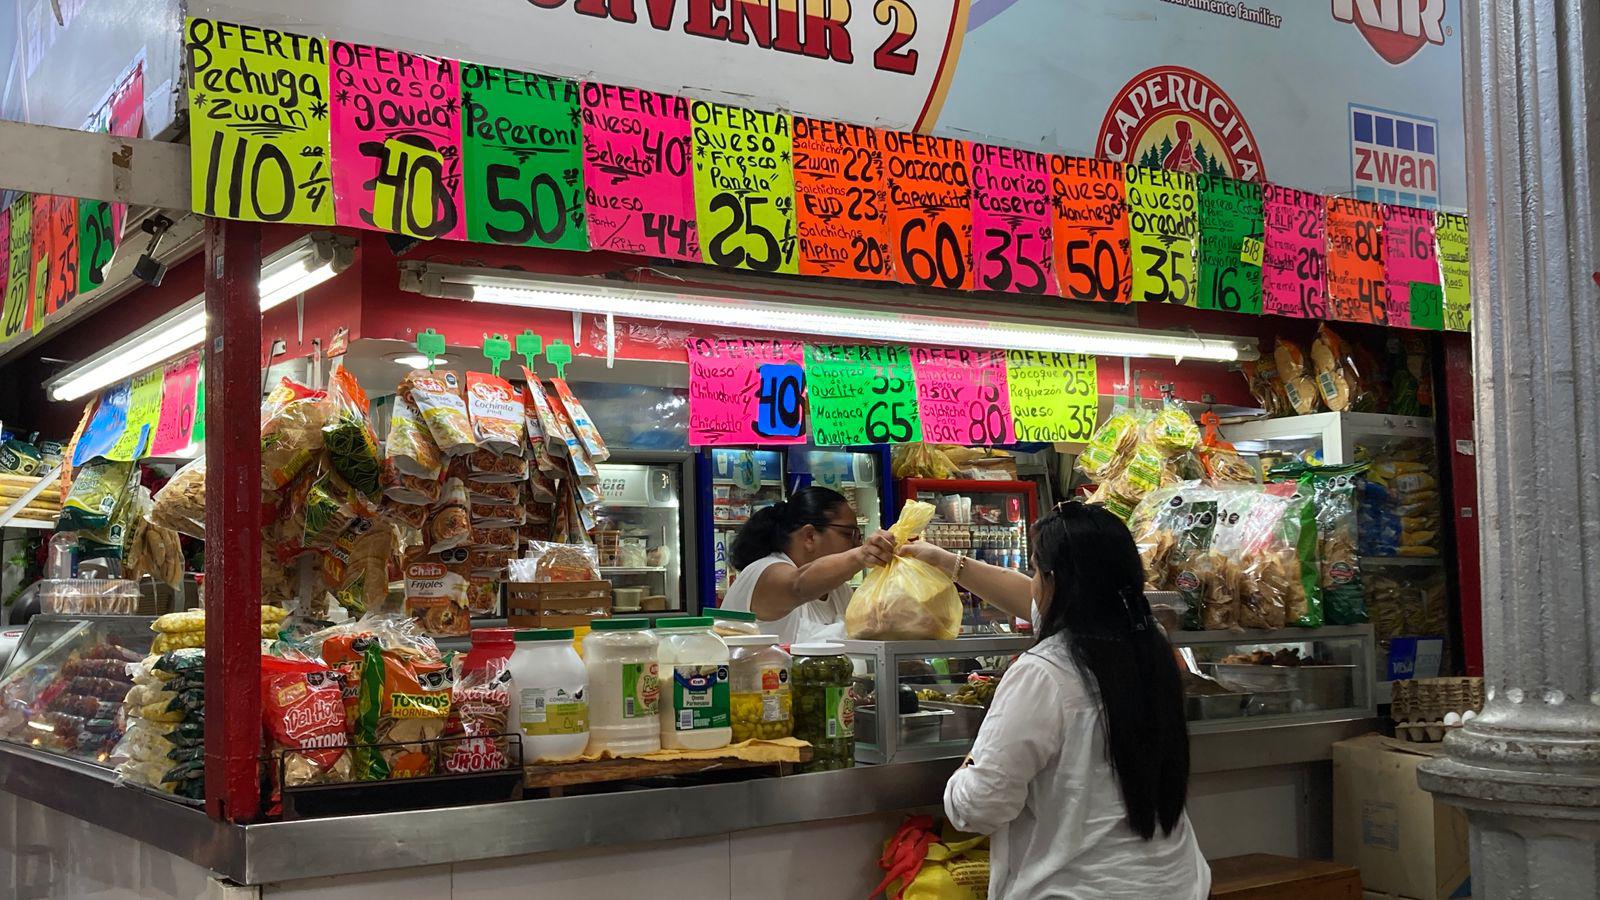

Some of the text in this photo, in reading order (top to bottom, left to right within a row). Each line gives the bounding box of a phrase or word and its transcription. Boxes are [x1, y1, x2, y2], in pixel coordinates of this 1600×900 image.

[1237, 3, 1282, 28] familiar
[190, 18, 326, 65] OFERTA
[873, 0, 918, 76] 2
[186, 42, 323, 109] Pechuga
[332, 41, 454, 84] OFERTA
[336, 68, 446, 101] Queso
[461, 63, 581, 105] OFERTA
[583, 82, 690, 121] OFERTA
[582, 107, 642, 136] Queso
[691, 100, 789, 137] OFERTA
[793, 116, 879, 151] OFERTA
[1104, 74, 1259, 180] CAPERUCITA
[585, 127, 687, 178] Selecto 40
[693, 127, 776, 153] Queso
[884, 131, 966, 161] OFERTA
[205, 130, 296, 222] 110
[710, 151, 778, 170] Fresco
[842, 147, 874, 183] 22
[972, 143, 1048, 174] OFERTA
[1050, 155, 1122, 181] OFERTA
[1355, 147, 1438, 192] zwan
[972, 165, 1047, 195] Chorizo
[1053, 177, 1119, 201] Queso
[1125, 164, 1196, 191] OFERTA
[1196, 173, 1263, 201] OFERTA
[485, 163, 567, 245] 50
[585, 185, 643, 212] Queso
[803, 187, 879, 221] FUD 23
[979, 192, 1046, 216] Casero
[1129, 187, 1194, 211] Queso
[1262, 183, 1323, 210] OFERTA
[1327, 196, 1381, 220] OFERTA
[641, 212, 688, 256] 44
[708, 192, 782, 272] 25
[1297, 209, 1319, 239] 22
[1409, 222, 1429, 261] 16
[851, 235, 884, 275] 20
[900, 217, 966, 289] 60
[983, 227, 1047, 294] 35
[1066, 239, 1120, 301] 50
[1297, 246, 1321, 281] 20
[1140, 245, 1190, 305] 35
[1212, 266, 1241, 311] 16
[1300, 282, 1326, 319] 16
[1062, 368, 1091, 397] 25
[864, 400, 914, 444] 65
[968, 400, 1007, 445] 80
[1067, 404, 1094, 441] 35
[410, 580, 444, 591] Frijoles
[391, 693, 450, 708] TOTOPOS
